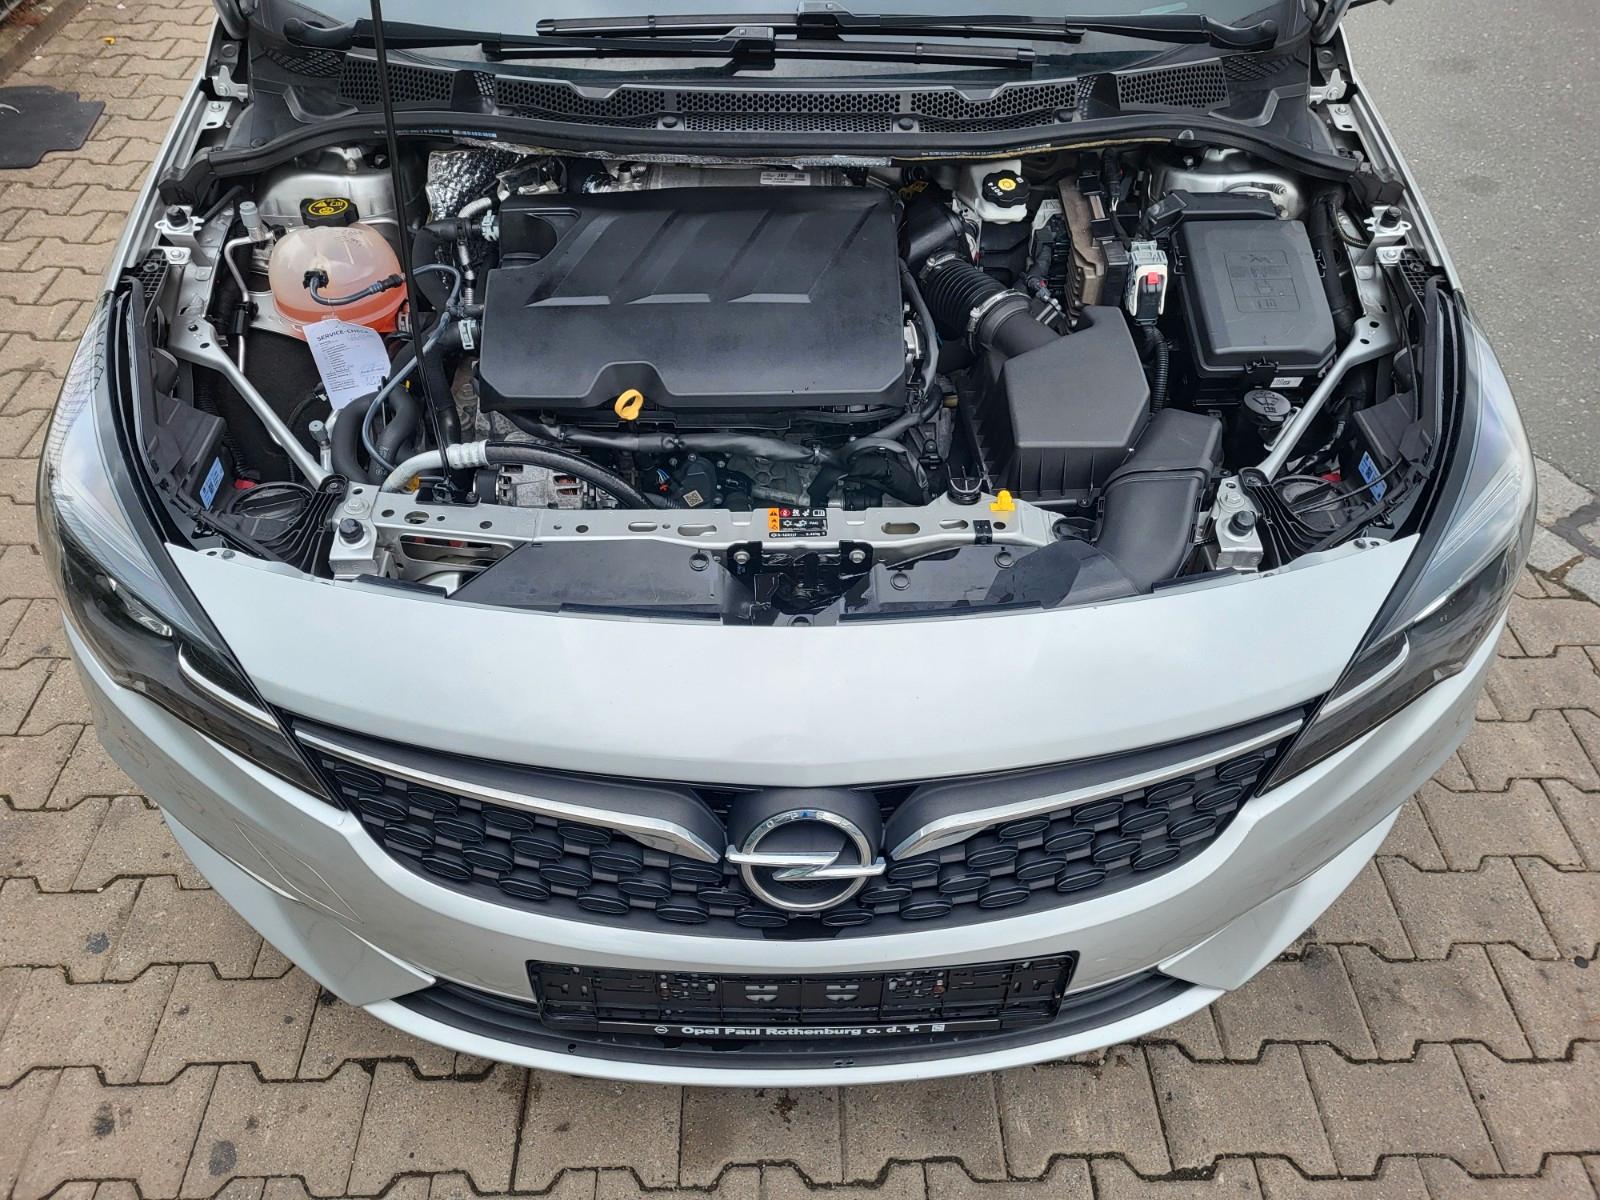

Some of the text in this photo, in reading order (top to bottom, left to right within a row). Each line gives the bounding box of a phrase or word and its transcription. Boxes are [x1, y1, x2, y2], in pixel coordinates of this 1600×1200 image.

[681, 1026, 720, 1036] Opel
[724, 1027, 761, 1036] Paul
[765, 1027, 862, 1036] Rothenburg
